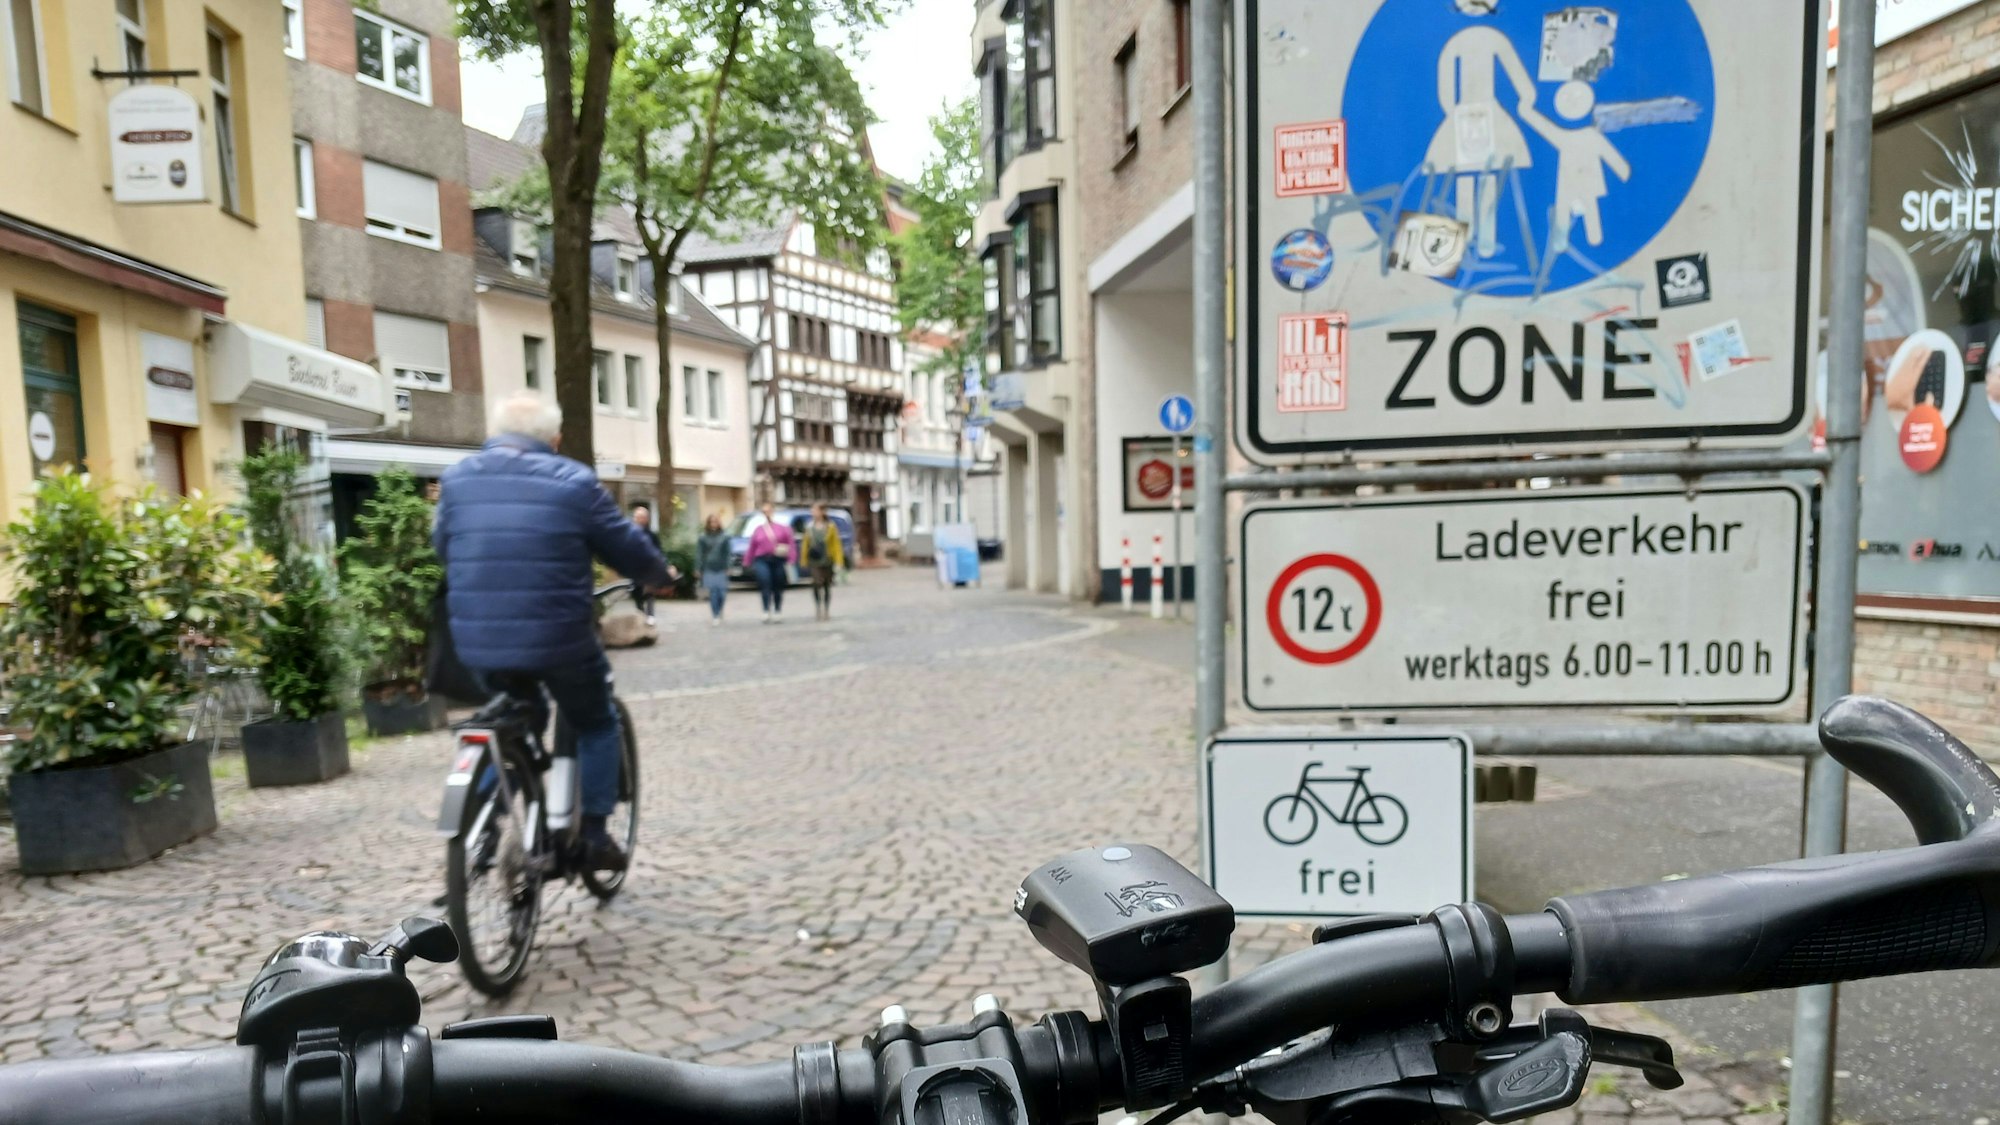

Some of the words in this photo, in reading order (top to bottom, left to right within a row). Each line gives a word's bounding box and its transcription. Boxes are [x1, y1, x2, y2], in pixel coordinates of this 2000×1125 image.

[1385, 318, 1658, 409] ZONE
[1435, 513, 1743, 561] Ladeverkehr
[1291, 586, 1334, 632] 12
[1547, 579, 1624, 619] frei
[1405, 646, 1550, 686] werktags
[1754, 640, 1771, 675] h
[1300, 860, 1374, 895] frei
